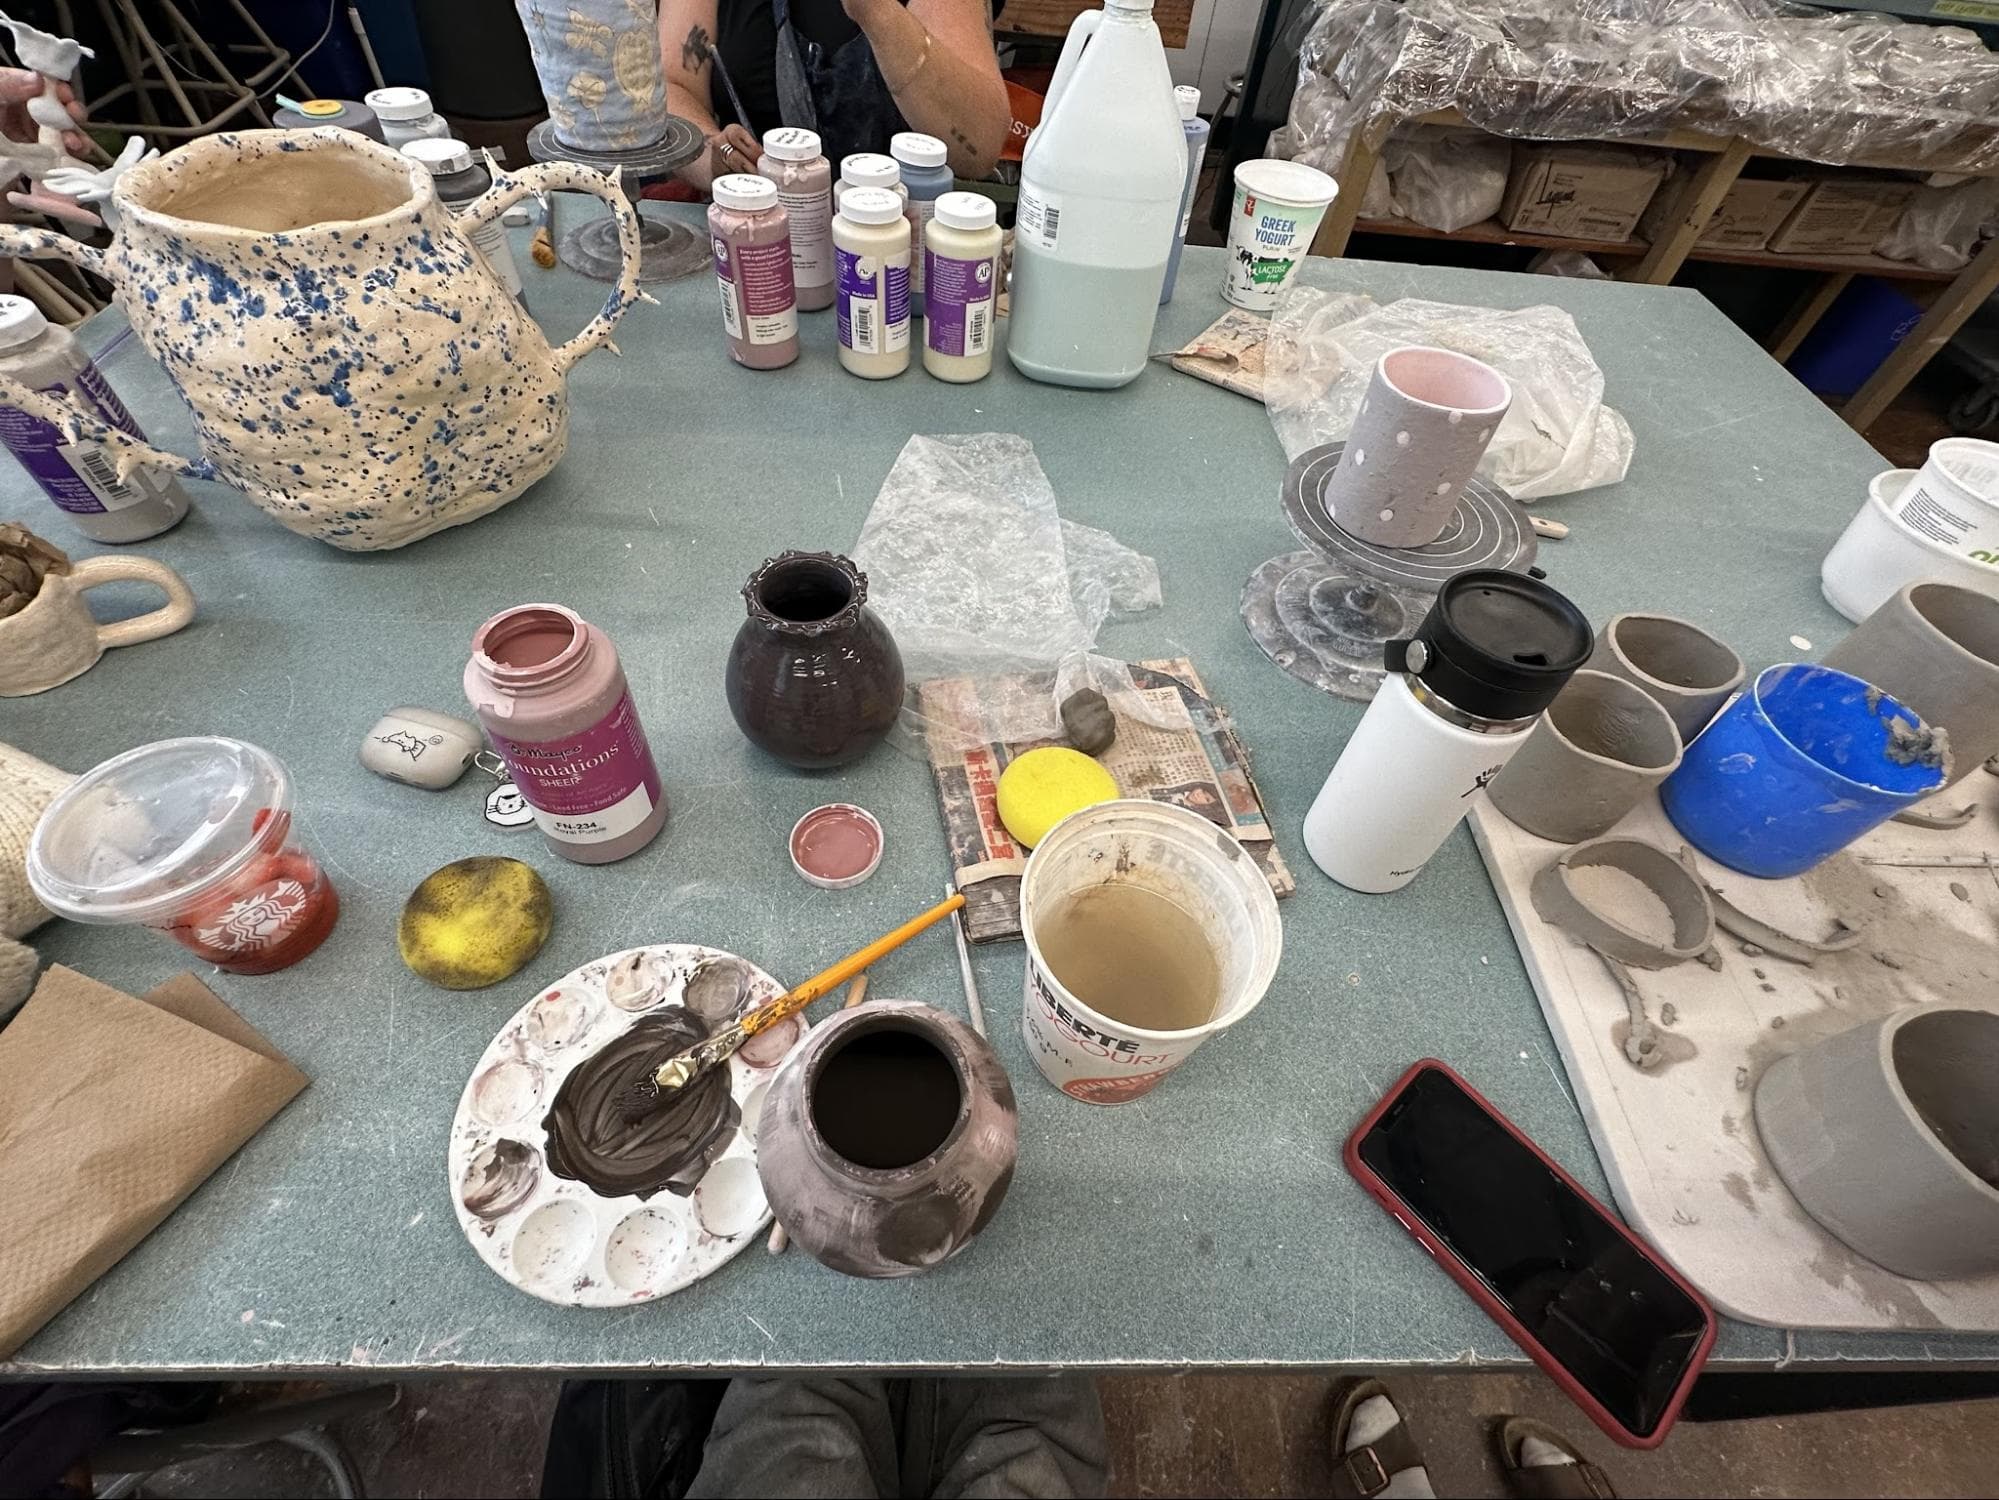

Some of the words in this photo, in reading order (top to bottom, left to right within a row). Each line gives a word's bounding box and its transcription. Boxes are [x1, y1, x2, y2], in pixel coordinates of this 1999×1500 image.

[1261, 215, 1297, 233] GREEK
[1255, 228, 1296, 246] YOGURT
[1258, 264, 1287, 273] LACTOSE
[508, 745, 618, 777] oundations
[539, 775, 582, 788] SHEER
[555, 821, 598, 830] FN-234
